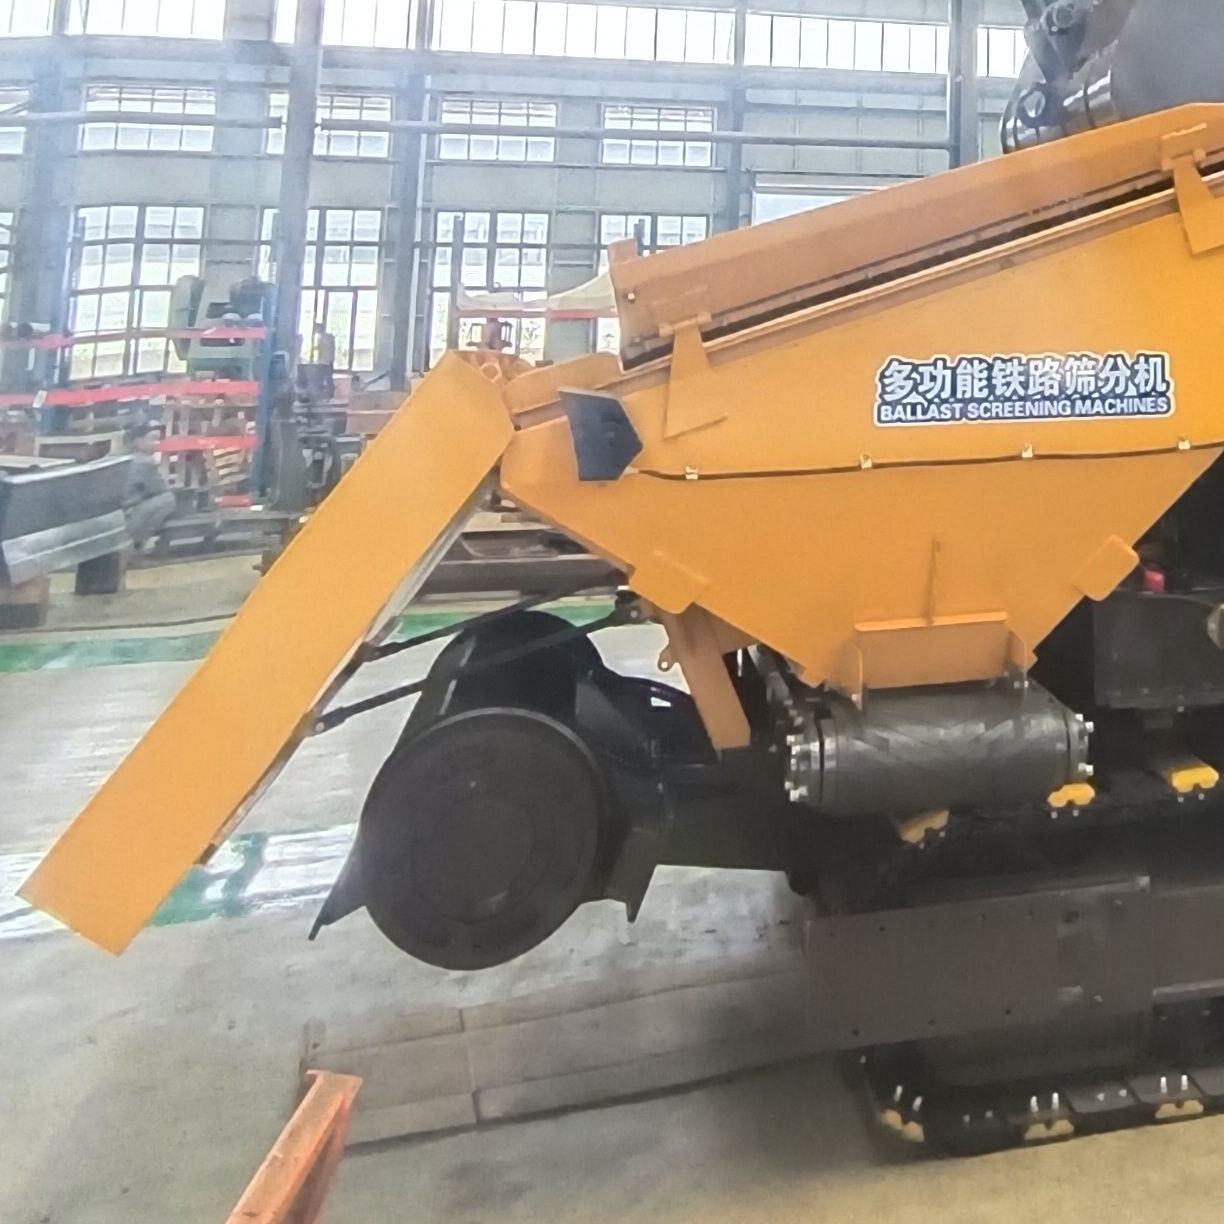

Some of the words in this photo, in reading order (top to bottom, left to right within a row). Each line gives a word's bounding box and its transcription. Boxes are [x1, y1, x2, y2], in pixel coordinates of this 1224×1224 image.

[882, 355, 1168, 402] 多功能铁路筛分机
[879, 402, 964, 421] BALLAST
[966, 398, 1072, 419] SCREENING
[1074, 396, 1169, 416] MACHINES
